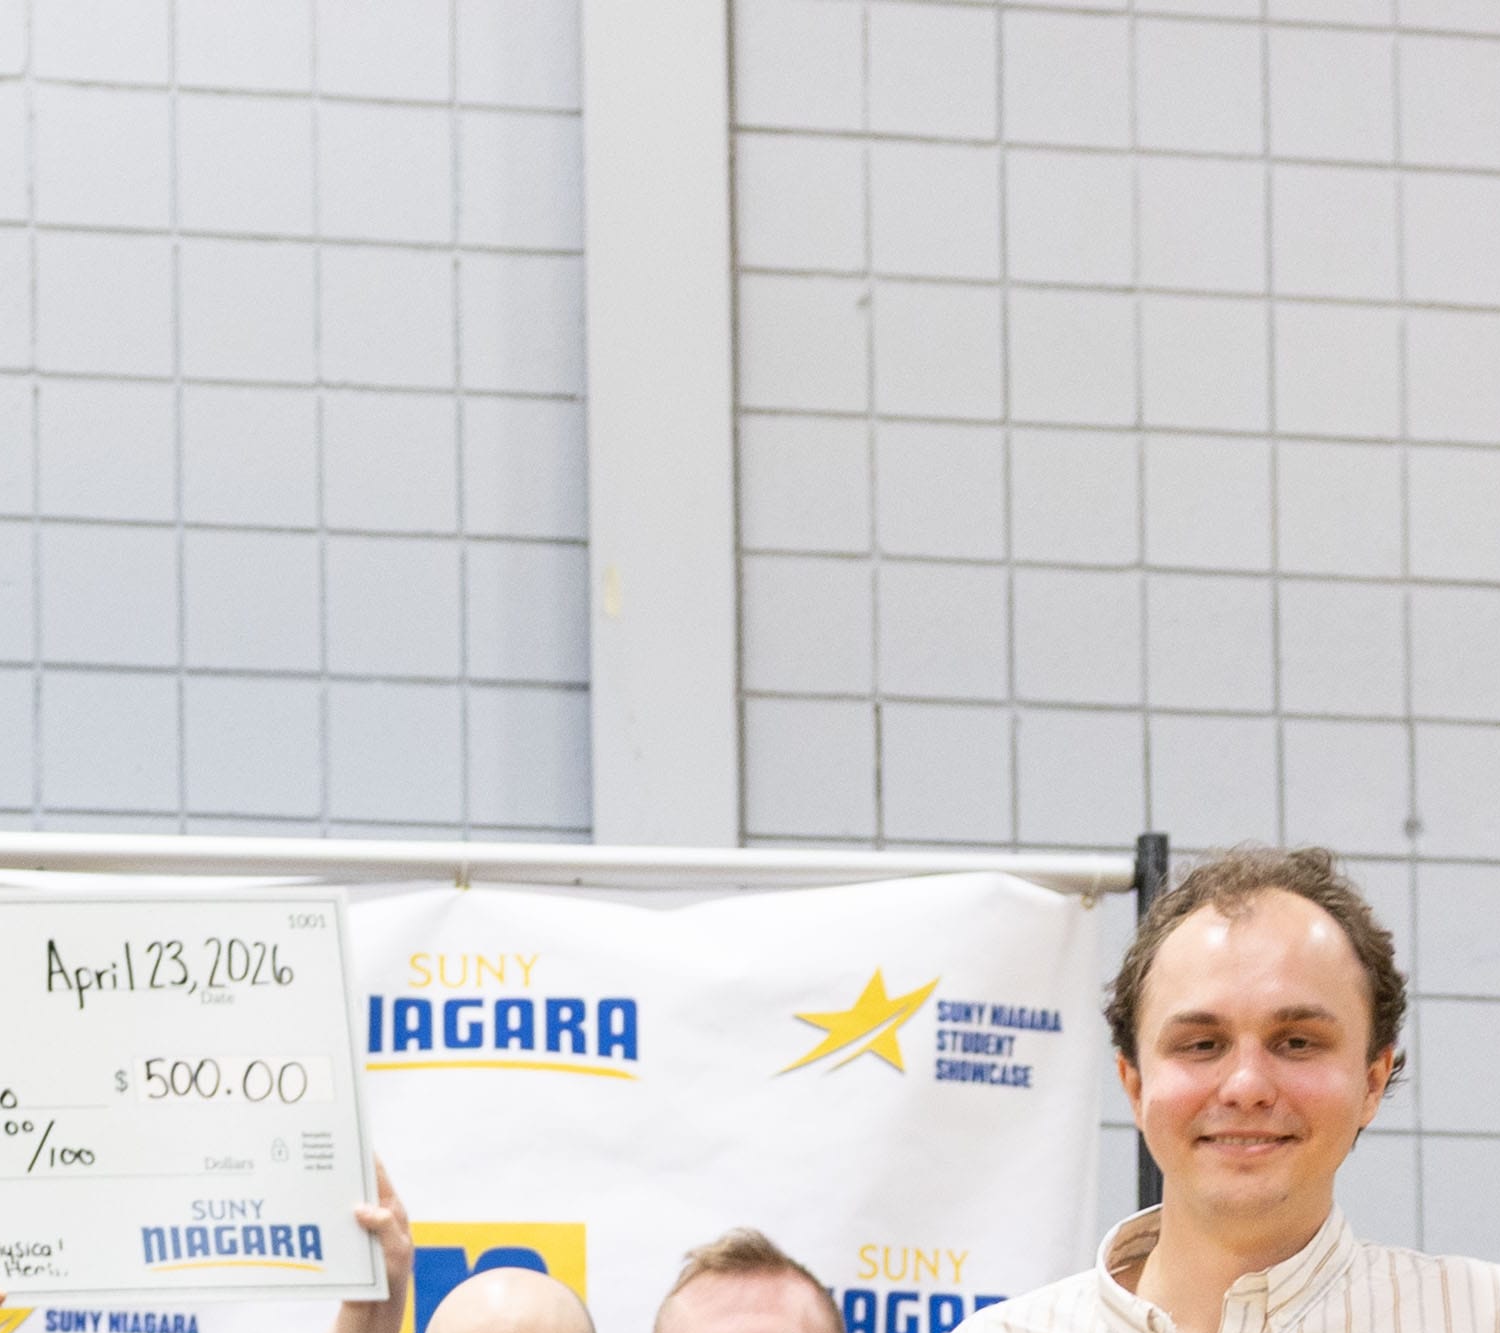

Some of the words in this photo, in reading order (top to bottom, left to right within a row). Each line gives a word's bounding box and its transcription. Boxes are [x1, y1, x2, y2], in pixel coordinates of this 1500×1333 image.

[288, 915, 326, 929] 1001
[47, 939, 135, 1009] April
[409, 953, 539, 989] SUNY
[367, 995, 638, 1061] IAGARA
[937, 1000, 986, 1023] SUNY
[989, 1003, 1062, 1034] NIAGARA
[936, 1029, 1014, 1058] STUDENT
[145, 1059, 307, 1103] 500.00
[935, 1058, 1033, 1089] SHOWCASE
[193, 1200, 263, 1220] SUNY
[141, 1224, 323, 1263] NIAGARA
[858, 1245, 970, 1283] SUNY
[45, 1309, 102, 1333] SUNY
